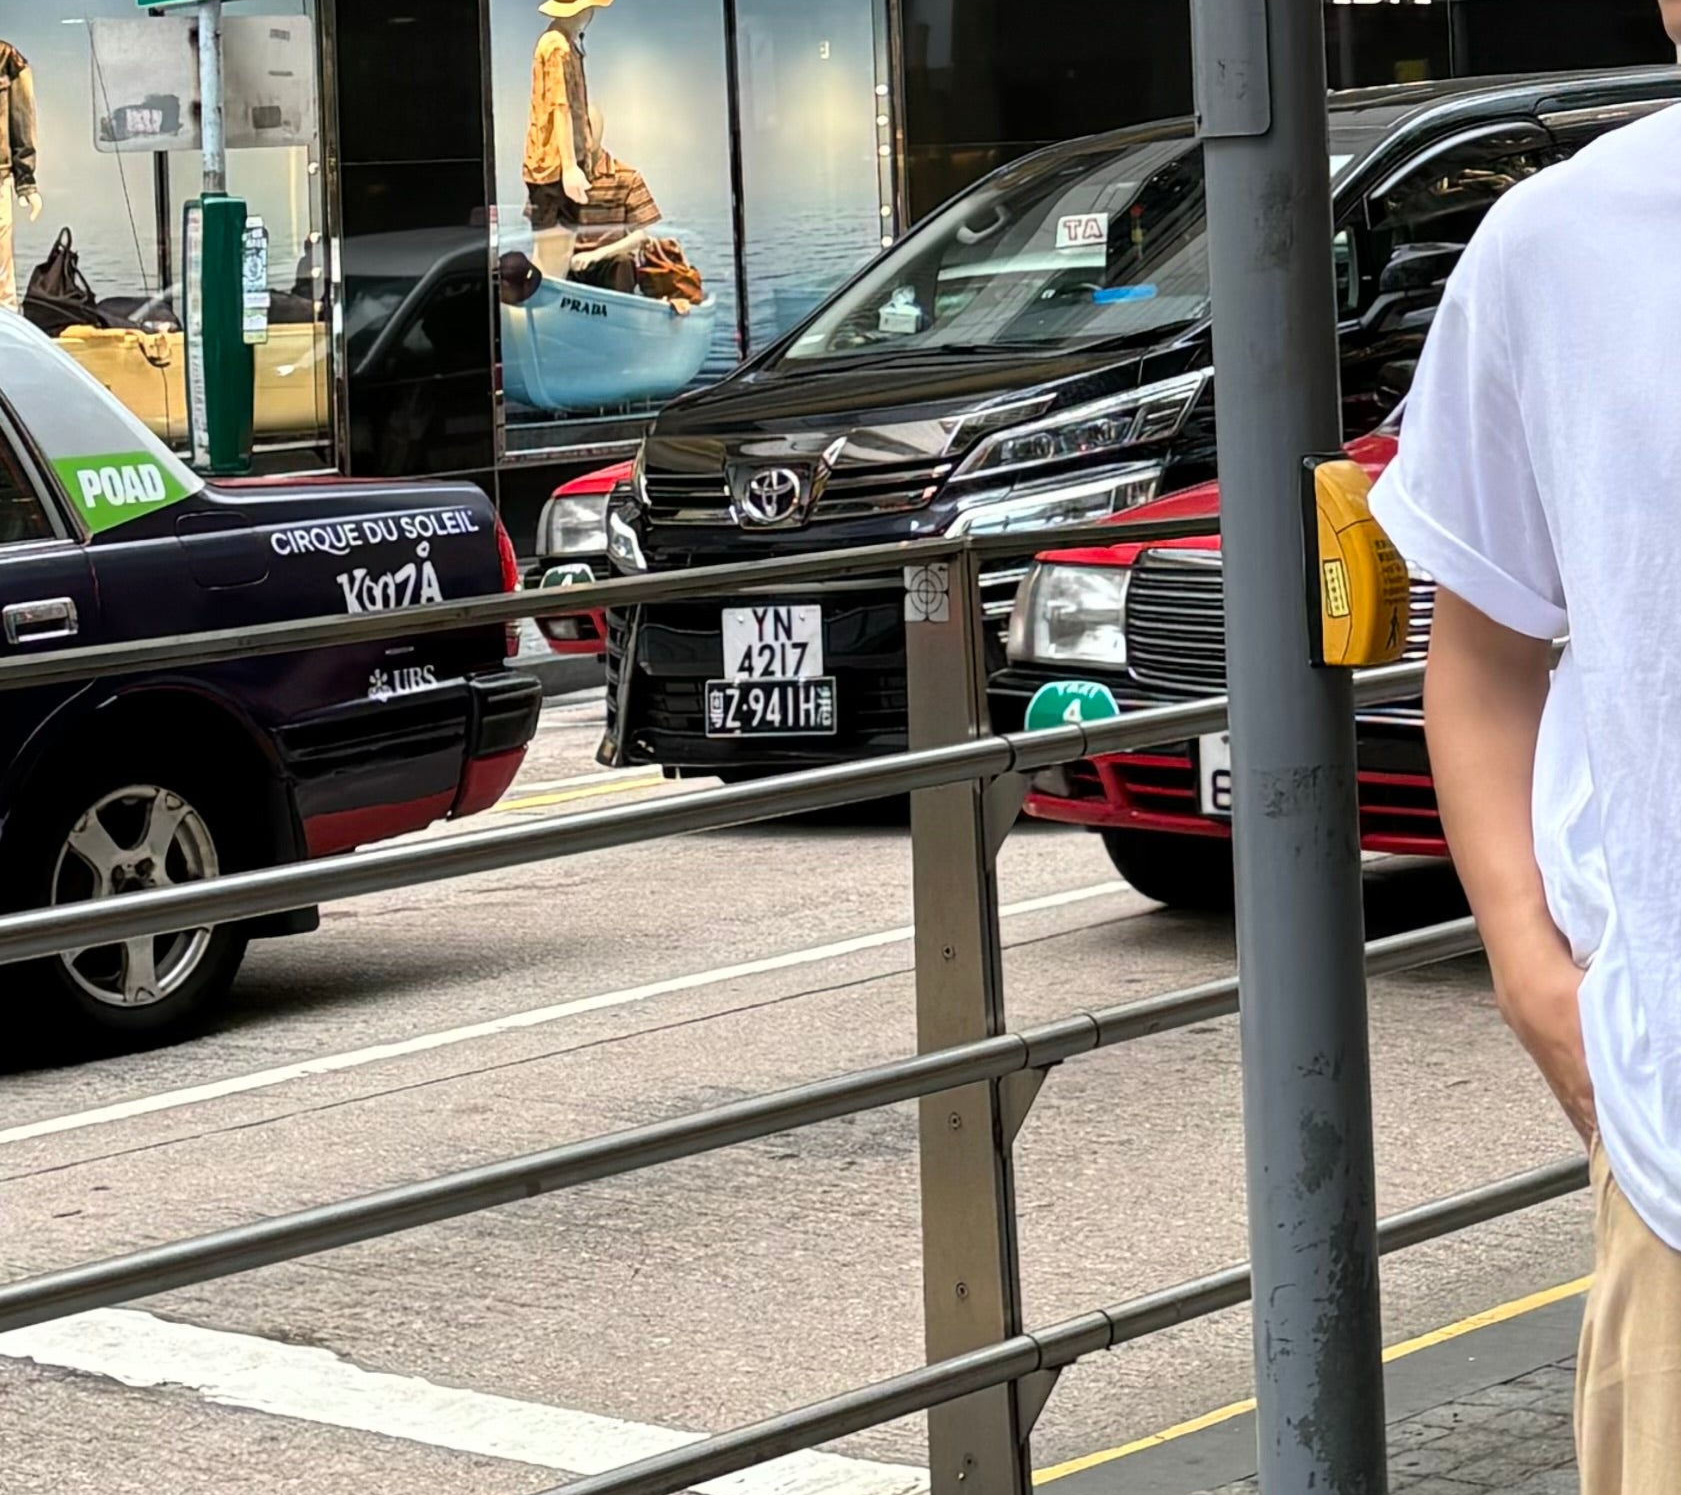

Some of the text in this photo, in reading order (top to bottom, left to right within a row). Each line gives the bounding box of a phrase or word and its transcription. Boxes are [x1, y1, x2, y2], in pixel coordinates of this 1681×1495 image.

[1064, 217, 1103, 241] TA
[560, 297, 608, 318] PRADA
[77, 463, 166, 508] POAD
[270, 510, 480, 555] CIRQUE DU SOLEIL
[752, 607, 793, 643] YN
[737, 641, 809, 678] 4217
[393, 664, 437, 694] UBS
